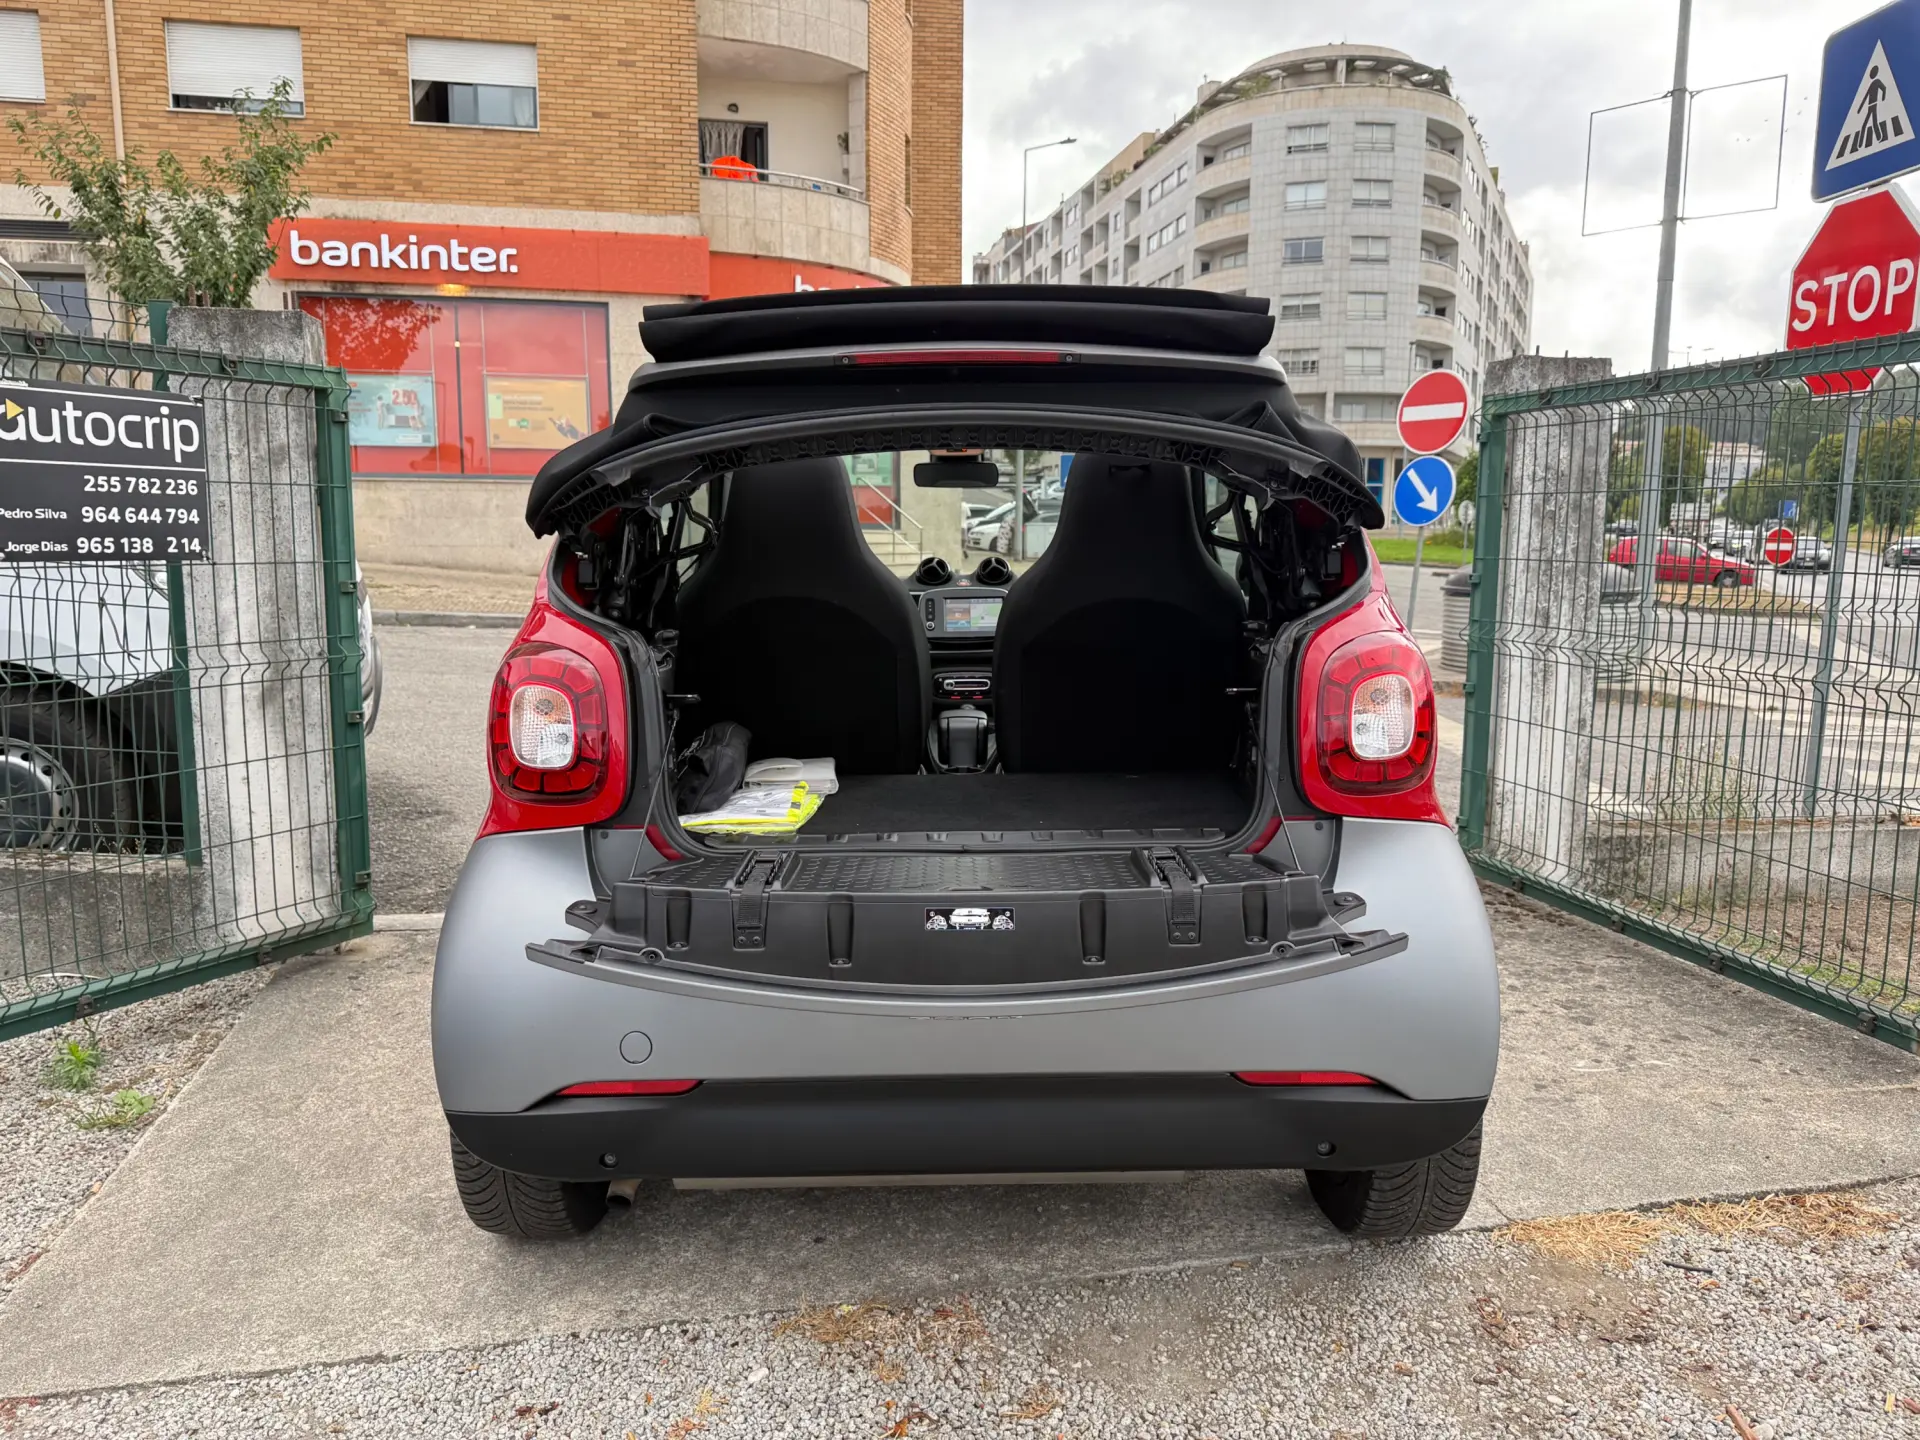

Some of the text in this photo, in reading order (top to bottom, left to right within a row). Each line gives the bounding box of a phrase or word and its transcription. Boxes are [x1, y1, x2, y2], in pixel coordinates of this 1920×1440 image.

[1792, 258, 1915, 332] STOP
[0, 401, 200, 463] autocrip
[83, 475, 198, 496] 255 782 236
[0, 506, 200, 525] Pedro Silva 964 644 794
[4, 536, 202, 554] Jorge Dias 965 138 214
